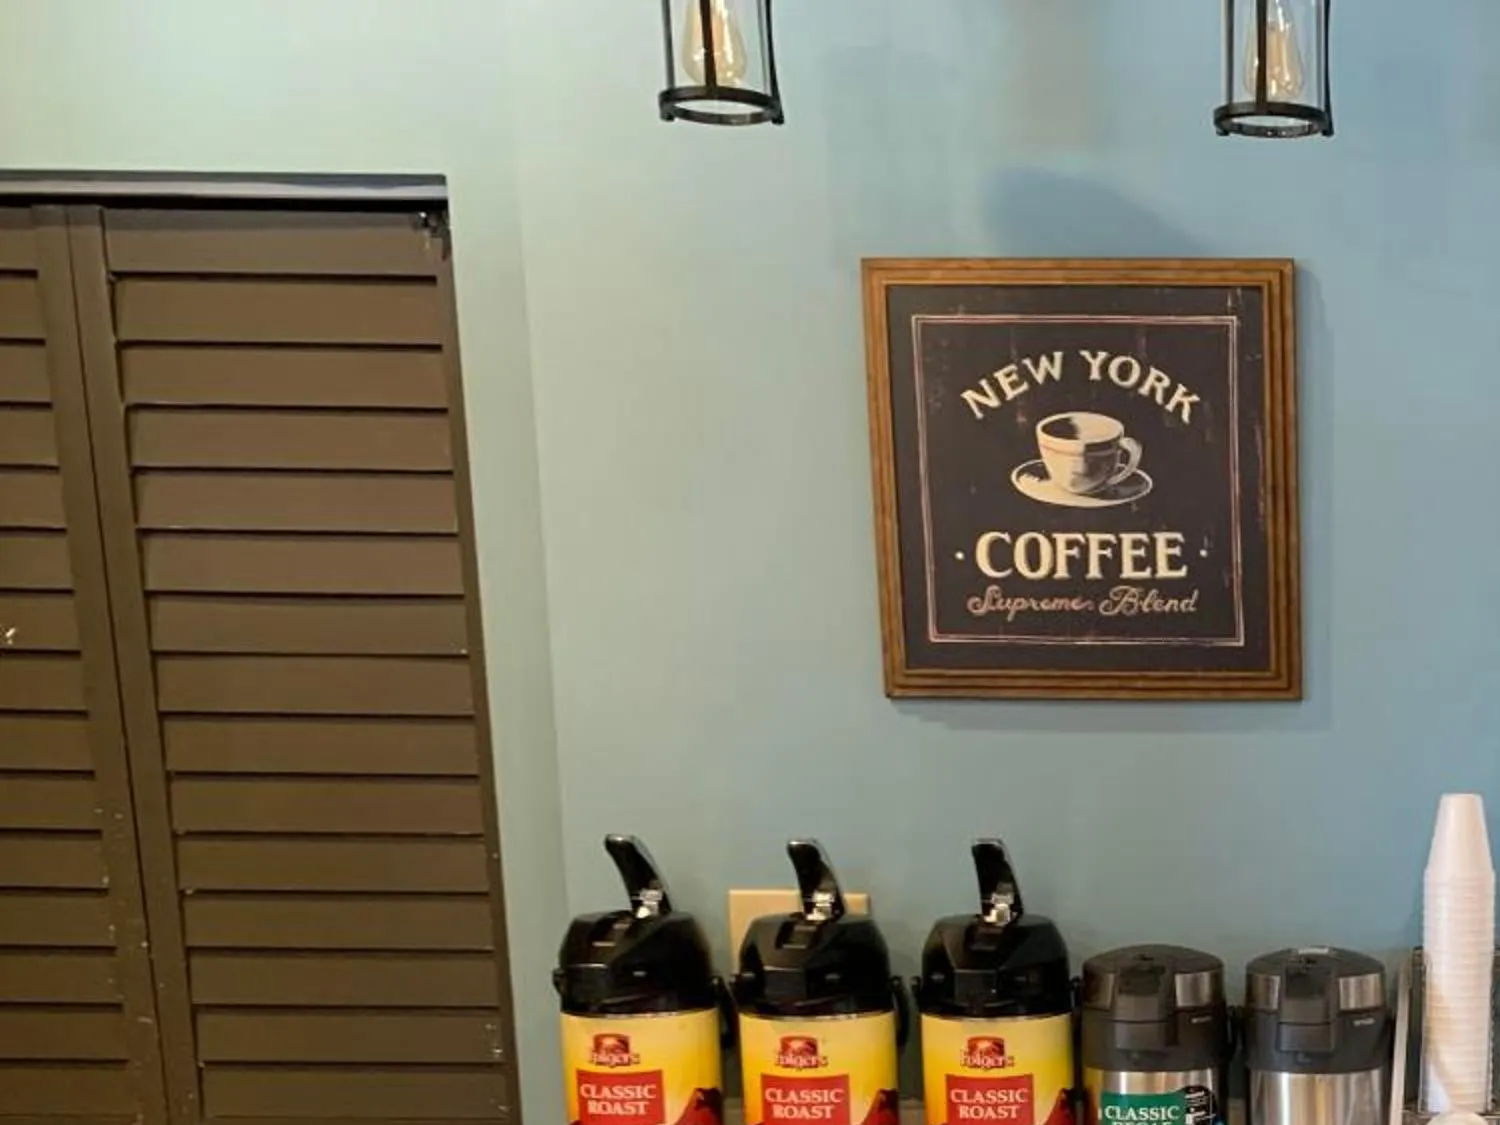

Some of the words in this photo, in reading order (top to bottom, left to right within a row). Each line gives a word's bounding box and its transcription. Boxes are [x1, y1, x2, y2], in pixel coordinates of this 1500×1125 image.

[960, 351, 1063, 419] NEW
[1079, 349, 1200, 424] YORK
[975, 531, 1188, 580] COFFEE
[966, 584, 1095, 622] Supreme
[1099, 585, 1199, 616] Blend
[580, 1083, 657, 1099] CLASSIC
[764, 1087, 844, 1103] CLASSIC
[950, 1087, 1029, 1104] CLASSIC
[587, 1099, 650, 1115] ROAST
[772, 1103, 835, 1119] ROAST
[958, 1103, 1020, 1120] ROAST
[1104, 1105, 1180, 1121] CLASSIC
